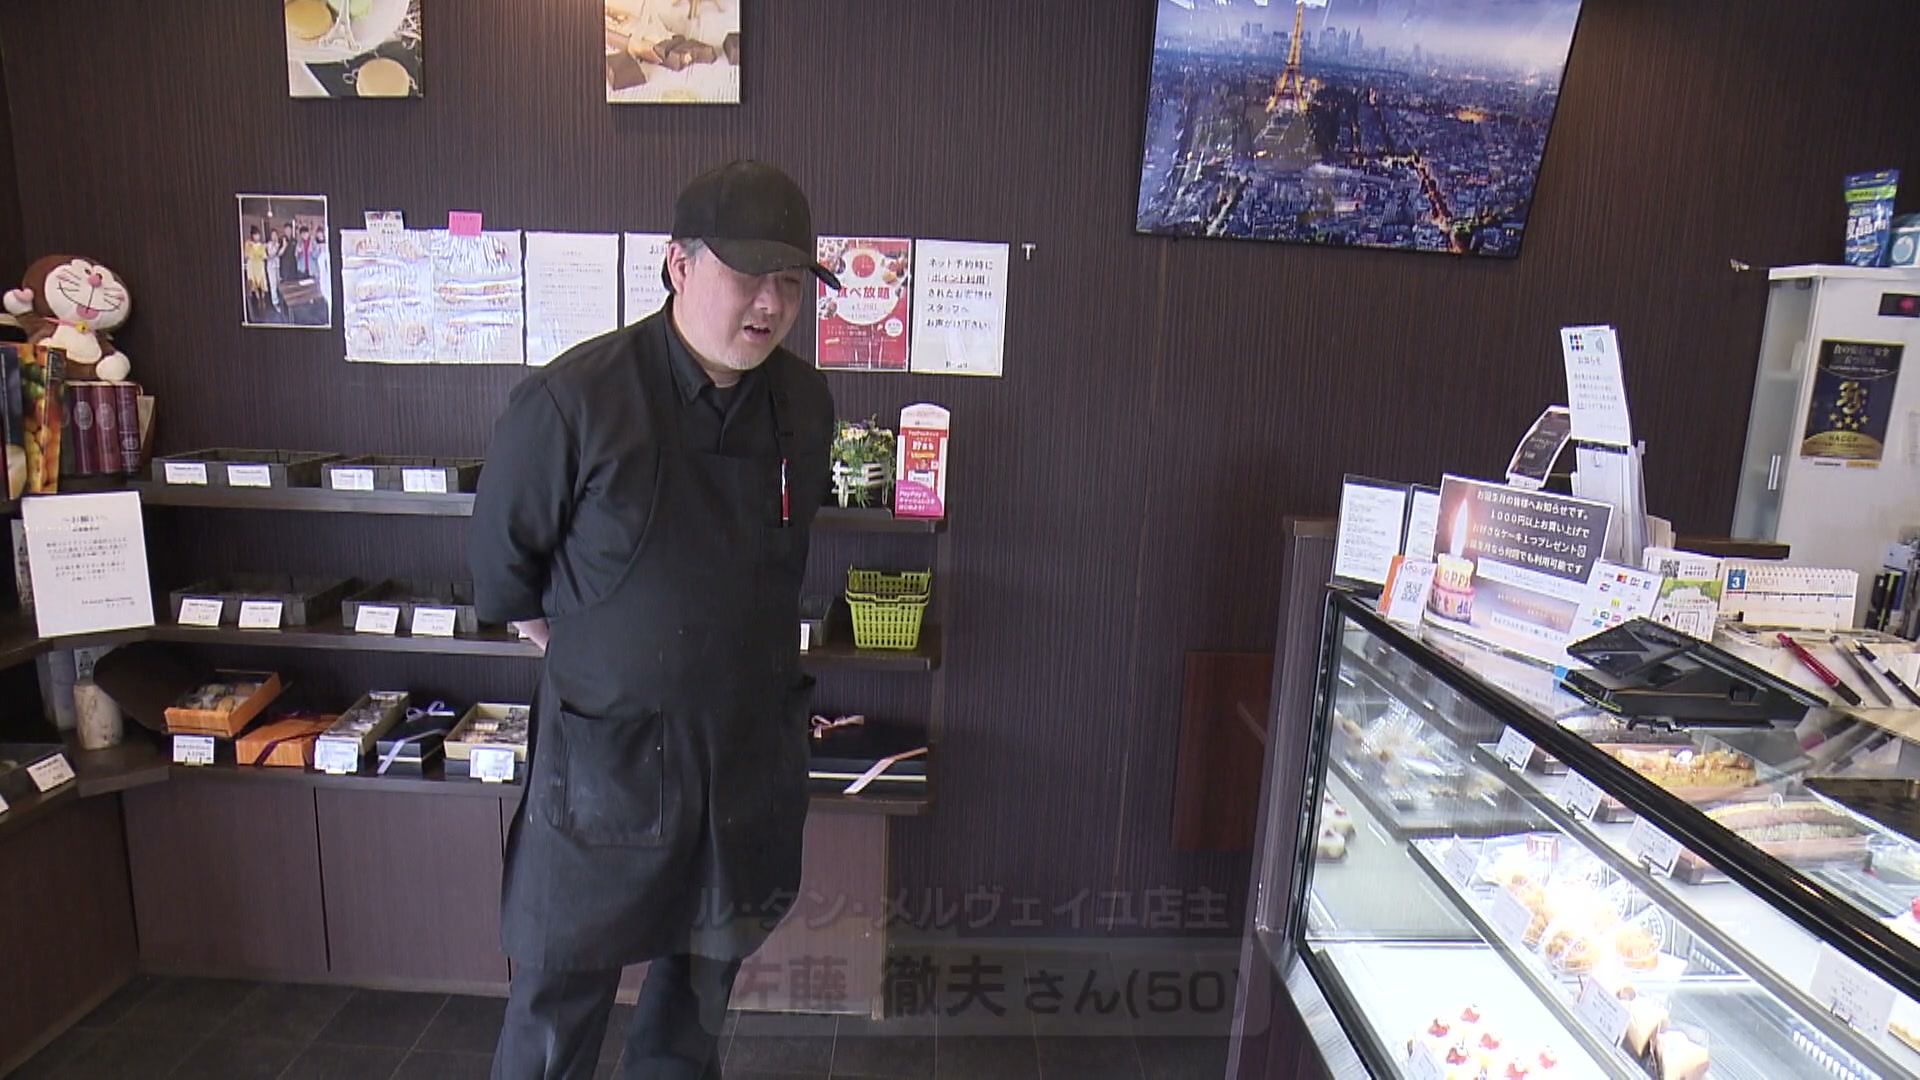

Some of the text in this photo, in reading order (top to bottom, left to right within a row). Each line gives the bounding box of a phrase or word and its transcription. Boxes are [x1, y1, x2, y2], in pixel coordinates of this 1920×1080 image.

[930, 257, 993, 270] ネット予約時に
[1731, 576, 1741, 589] 3
